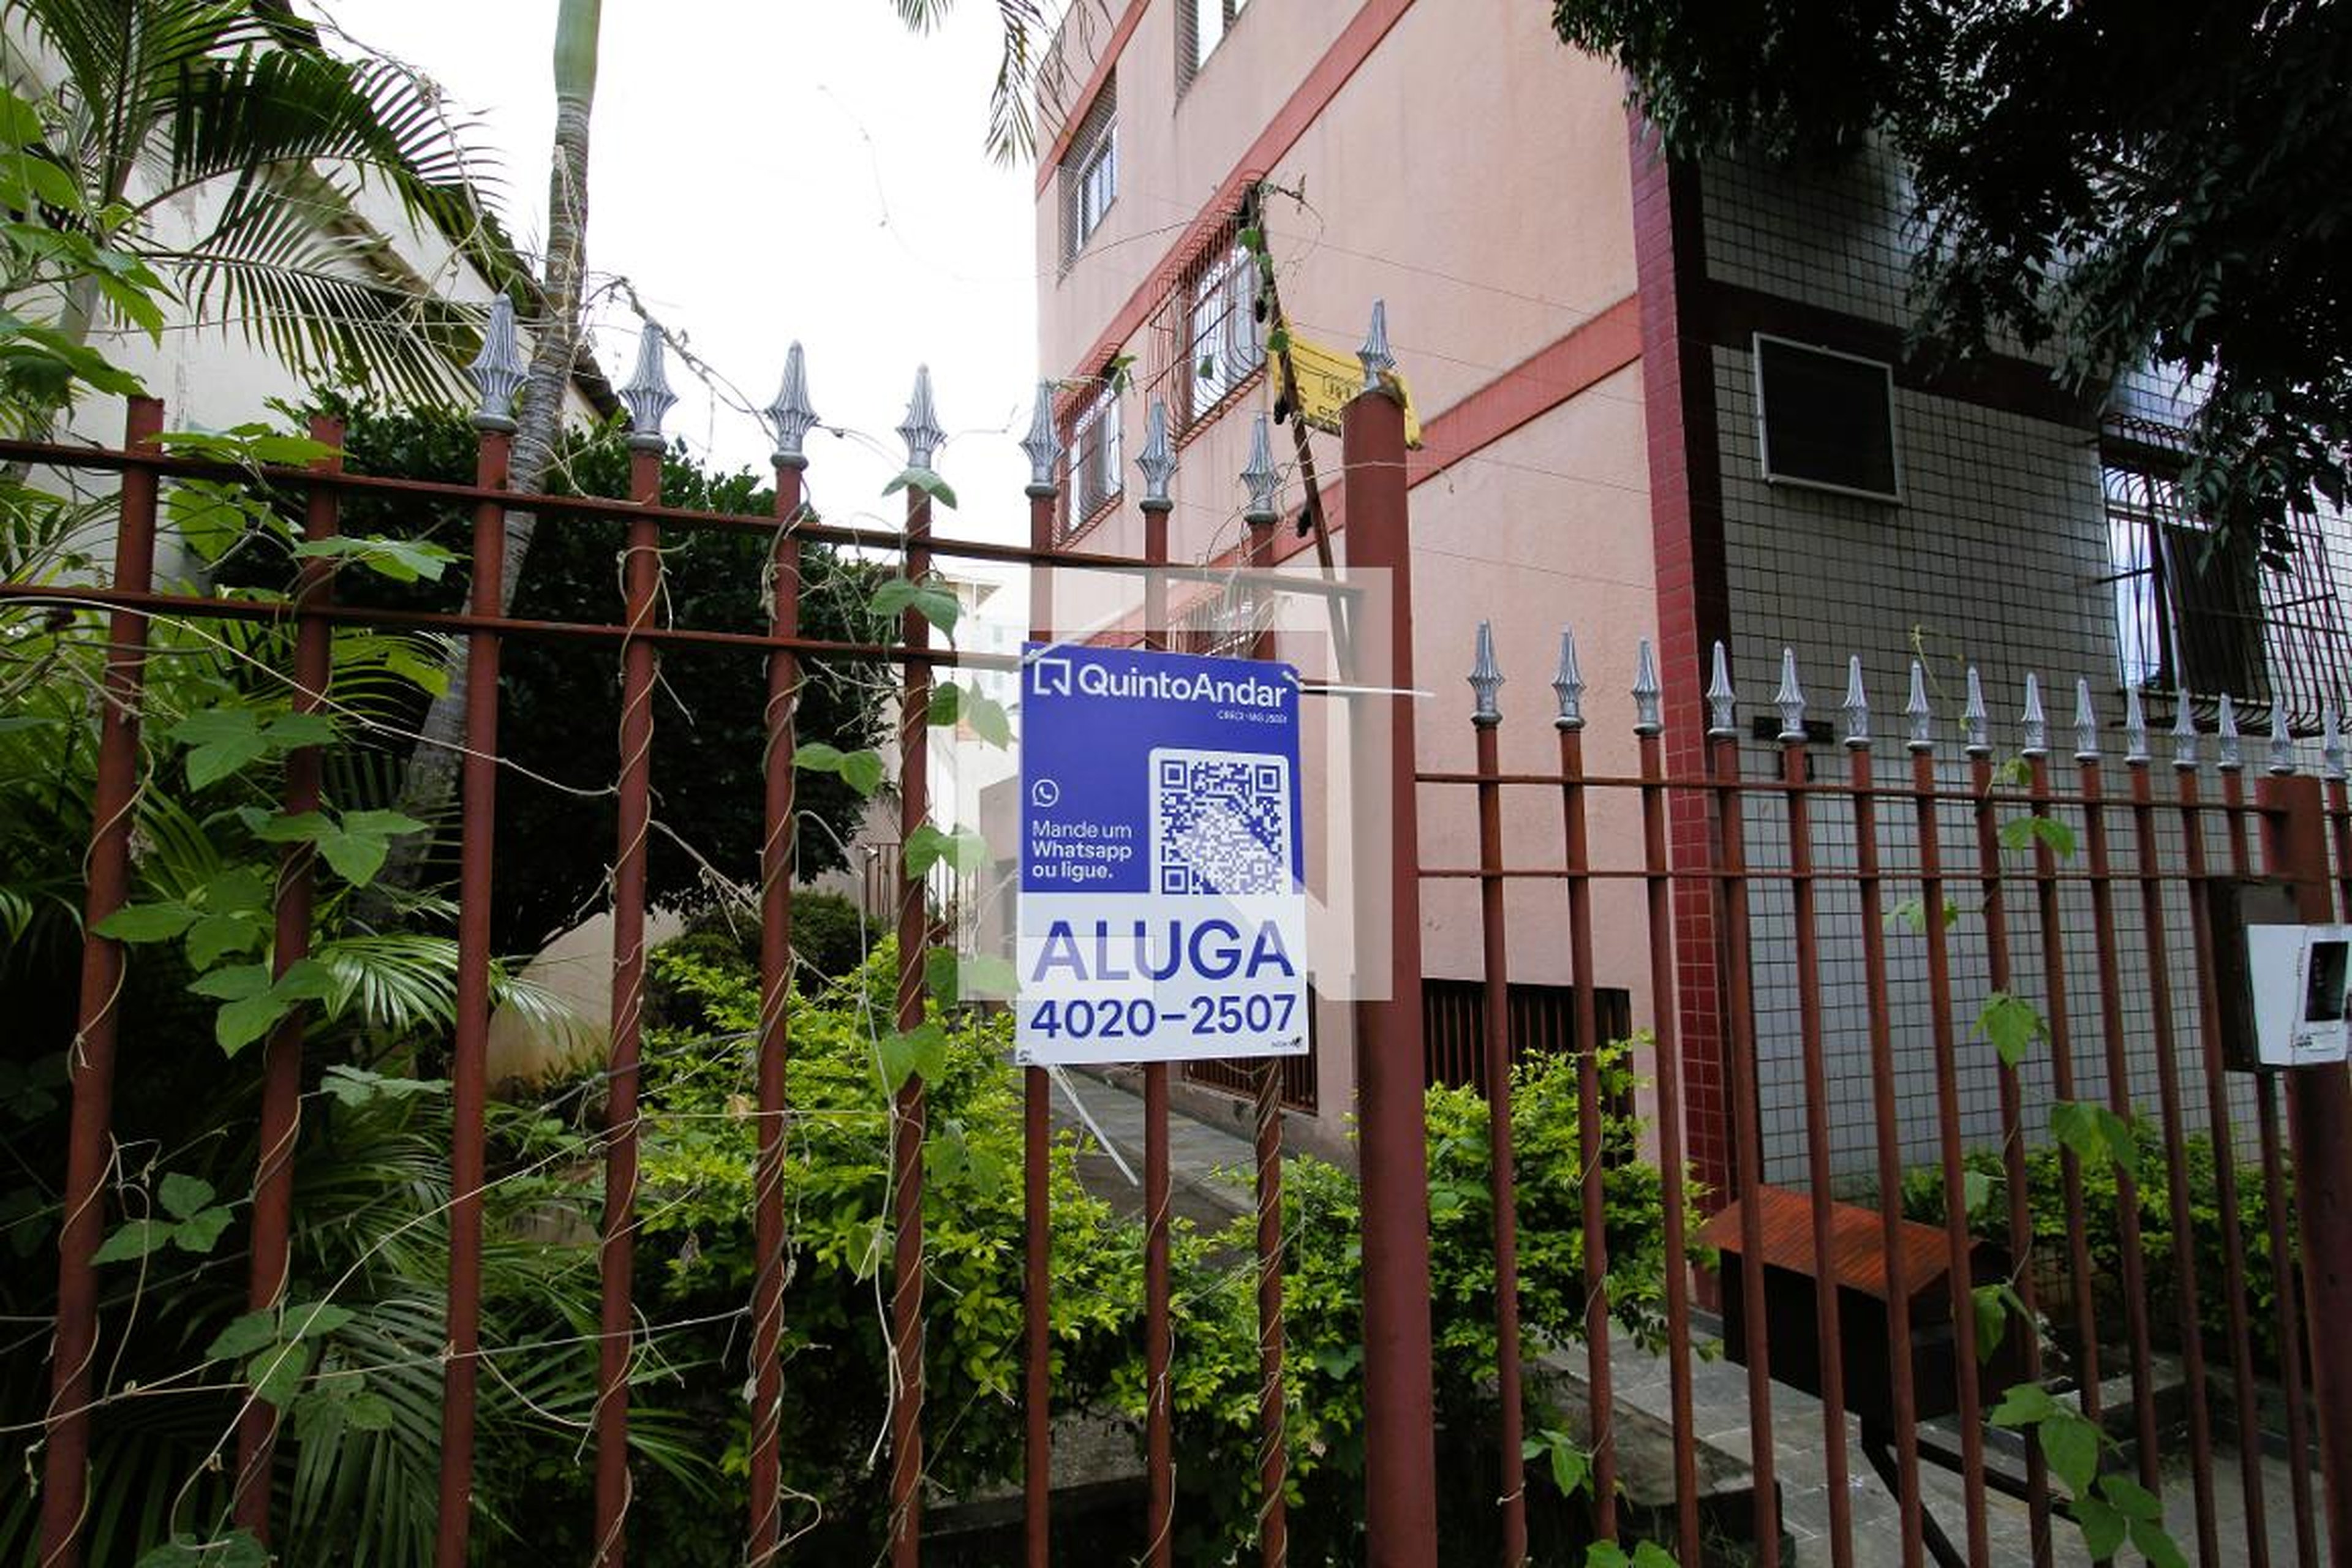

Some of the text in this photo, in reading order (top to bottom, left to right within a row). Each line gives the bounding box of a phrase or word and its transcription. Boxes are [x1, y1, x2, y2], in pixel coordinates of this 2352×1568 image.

[1078, 663, 1287, 708] QuintoAndar
[1032, 820, 1133, 839] Mande um
[1032, 841, 1133, 861] Whatsapp
[1032, 861, 1114, 883] ou ligue.
[1031, 919, 1295, 982] ALUGA
[1030, 994, 1297, 1039] 4020-2507
